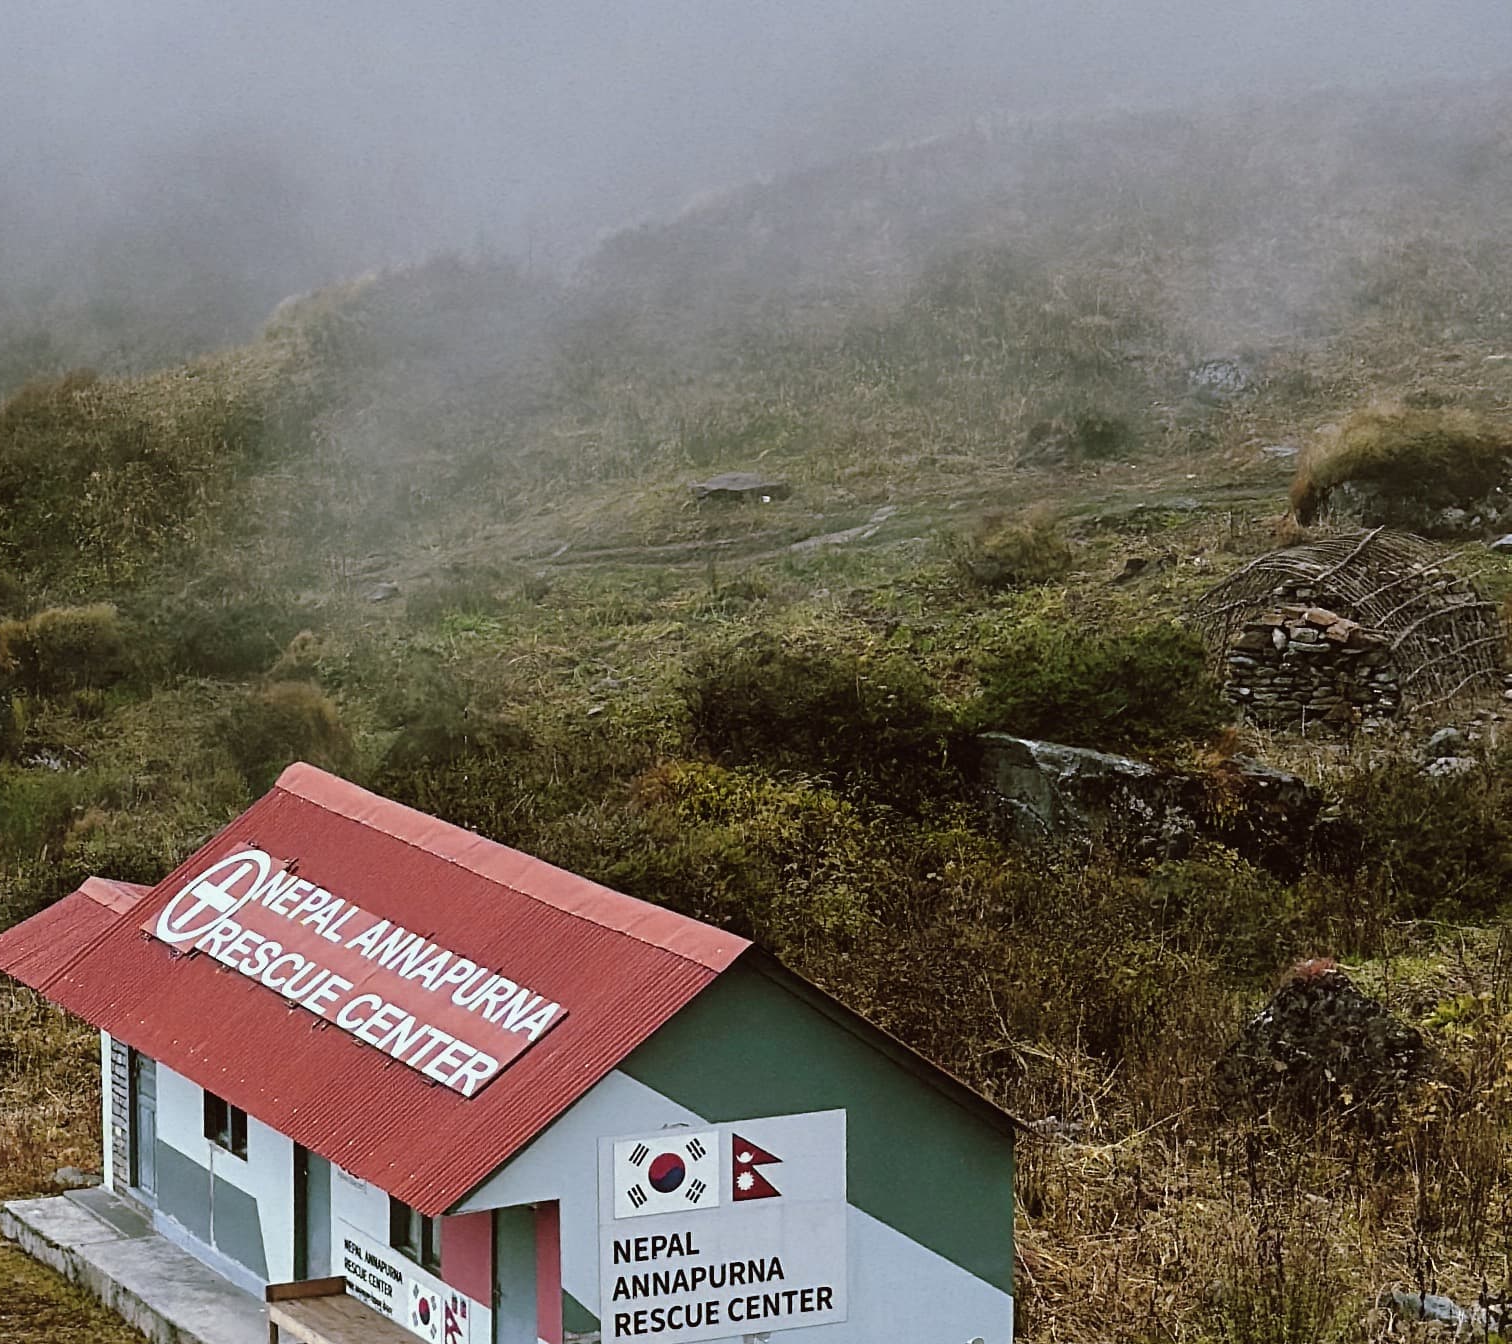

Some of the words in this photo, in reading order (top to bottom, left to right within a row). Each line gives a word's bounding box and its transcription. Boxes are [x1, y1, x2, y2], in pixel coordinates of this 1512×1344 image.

[252, 870, 359, 943] NEPAL
[346, 919, 560, 1041] ANNAPURNA
[195, 919, 354, 1015] RESCUE
[336, 994, 498, 1097] CENTER
[344, 1239, 363, 1260] NEPAL
[613, 1231, 700, 1265] NEPAL
[344, 1258, 367, 1282] RESCUE
[368, 1273, 393, 1297] CENTER
[612, 1257, 784, 1301] ANNAPURNA
[615, 1301, 720, 1337] RESCUE
[728, 1287, 833, 1322] CENTER
